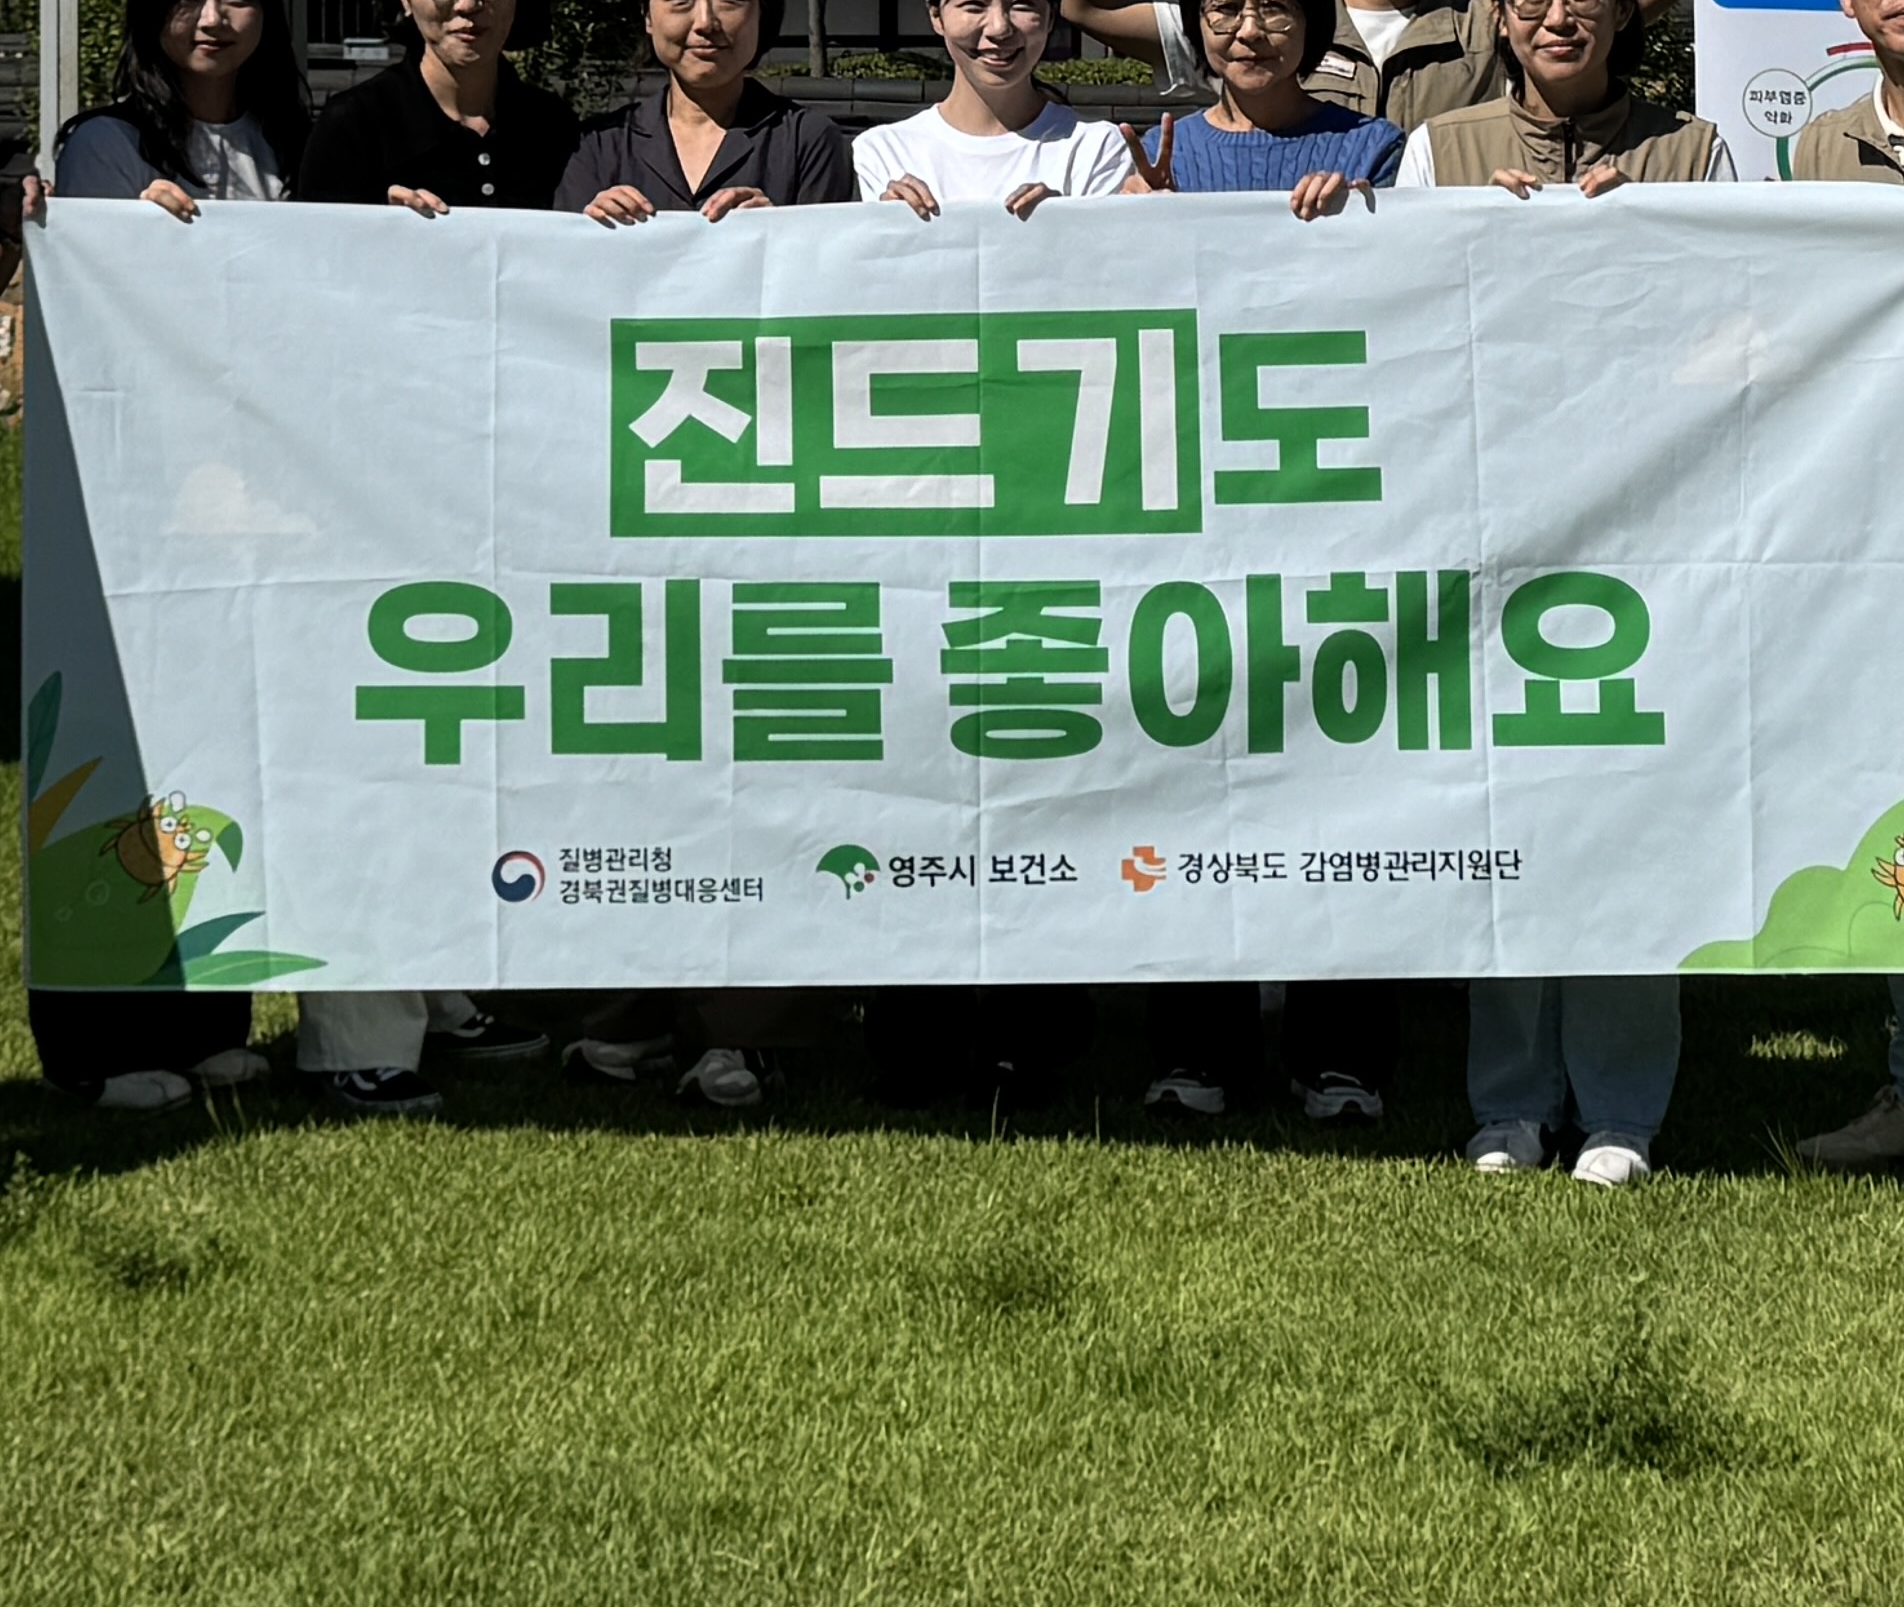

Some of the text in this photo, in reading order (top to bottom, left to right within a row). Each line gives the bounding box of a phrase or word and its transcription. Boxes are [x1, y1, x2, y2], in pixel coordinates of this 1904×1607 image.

[627, 327, 1383, 514] 진드기도
[354, 568, 1666, 765] 우리를 좋아해요
[559, 846, 672, 873] 질병관리청
[888, 853, 1078, 889] 영주시 보건소
[1178, 848, 1523, 884] 경상북도 감염병관리지원단
[560, 876, 763, 905] 경북권질병대응센터
